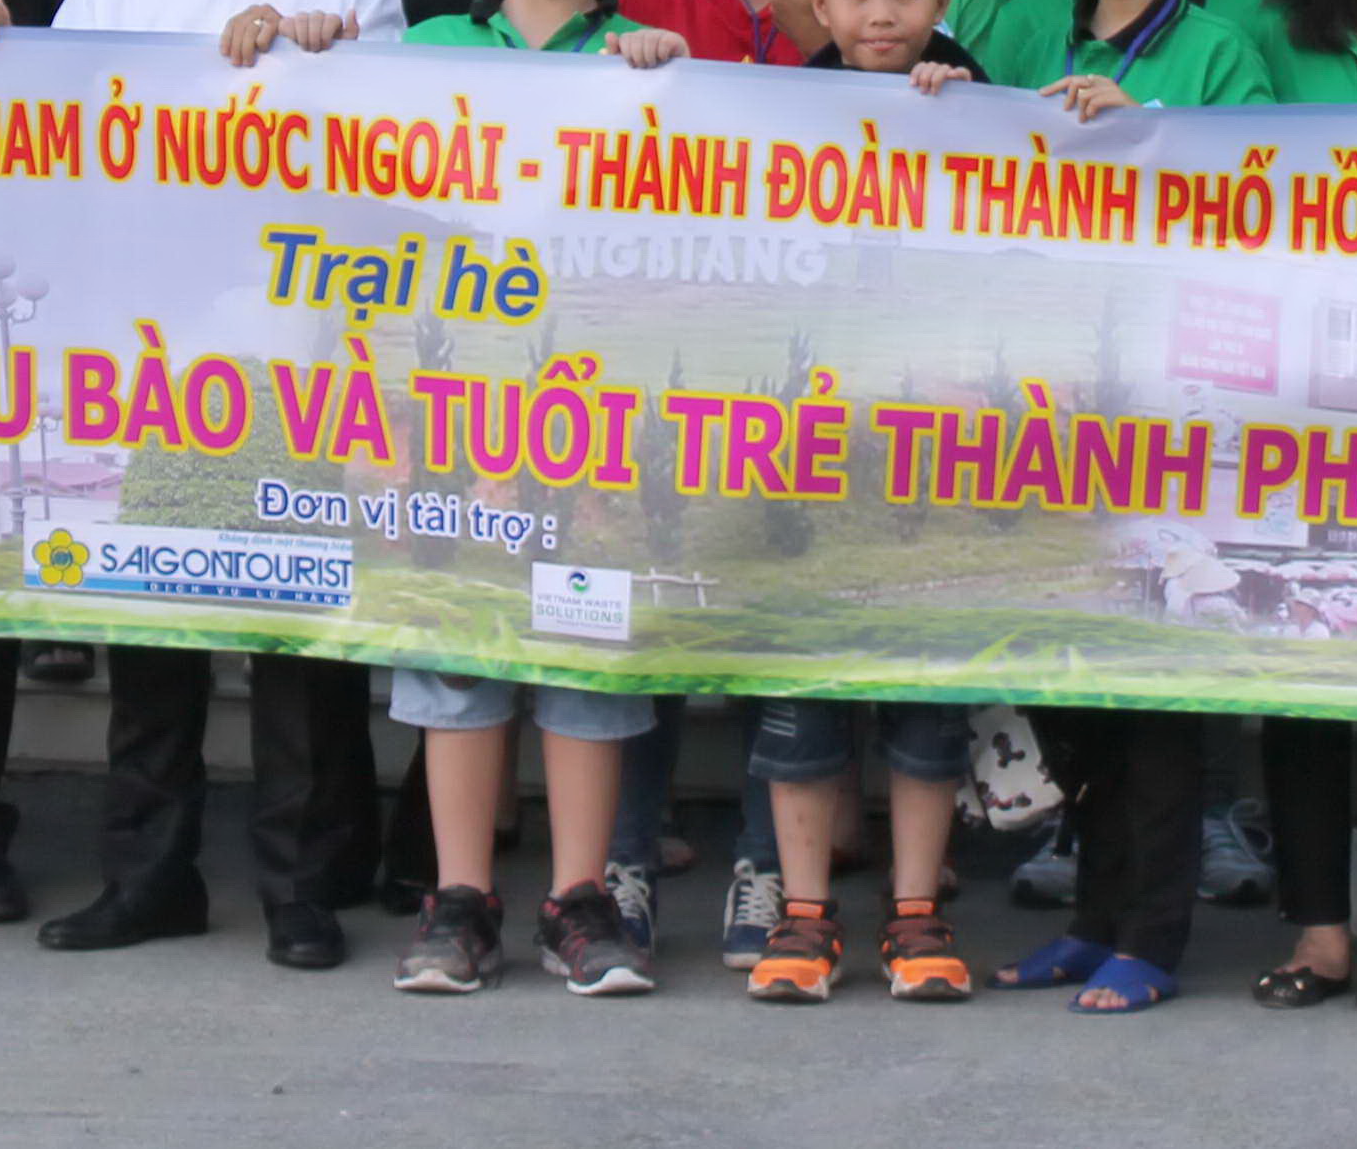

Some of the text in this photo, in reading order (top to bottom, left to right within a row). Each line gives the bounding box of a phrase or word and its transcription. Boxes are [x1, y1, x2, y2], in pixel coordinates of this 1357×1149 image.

[98, 78, 142, 181] Ở
[155, 85, 311, 191] NƯỚC
[326, 99, 506, 203] NGOÀI
[556, 107, 751, 217] THÀNH
[764, 121, 930, 230] ĐOÀN
[943, 133, 1140, 243] THÀNH
[1155, 146, 1277, 249] PHỐ
[268, 230, 541, 322] Trại hè
[68, 322, 248, 450] BÀO
[273, 340, 390, 461] VÀ
[413, 358, 638, 484] TUỔI
[665, 368, 846, 495] TRẺ
[874, 384, 1209, 512] THÀNH
[258, 481, 347, 522] Đơn
[362, 491, 396, 536] vị
[410, 493, 457, 533] tài
[471, 502, 531, 550] trợ
[100, 544, 353, 589] SAIGONTOURIST
[535, 603, 623, 624] SOLUTIONS
